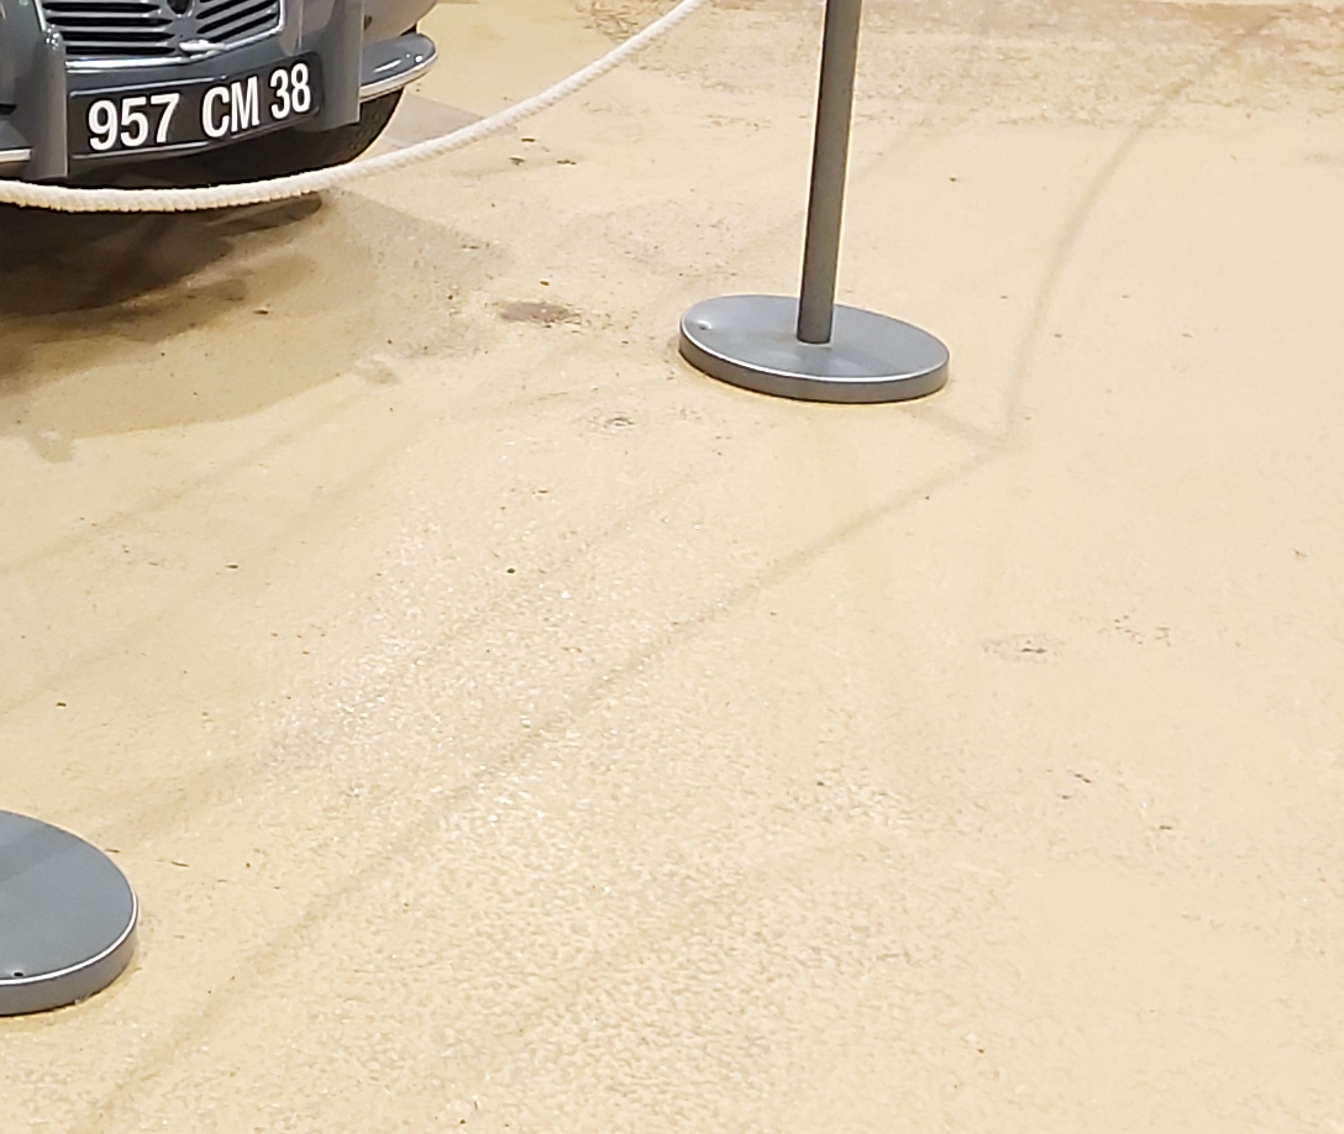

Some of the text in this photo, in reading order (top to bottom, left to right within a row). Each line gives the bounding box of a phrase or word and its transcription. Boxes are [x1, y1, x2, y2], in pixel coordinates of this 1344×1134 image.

[88, 62, 312, 151] 957 CM 38
